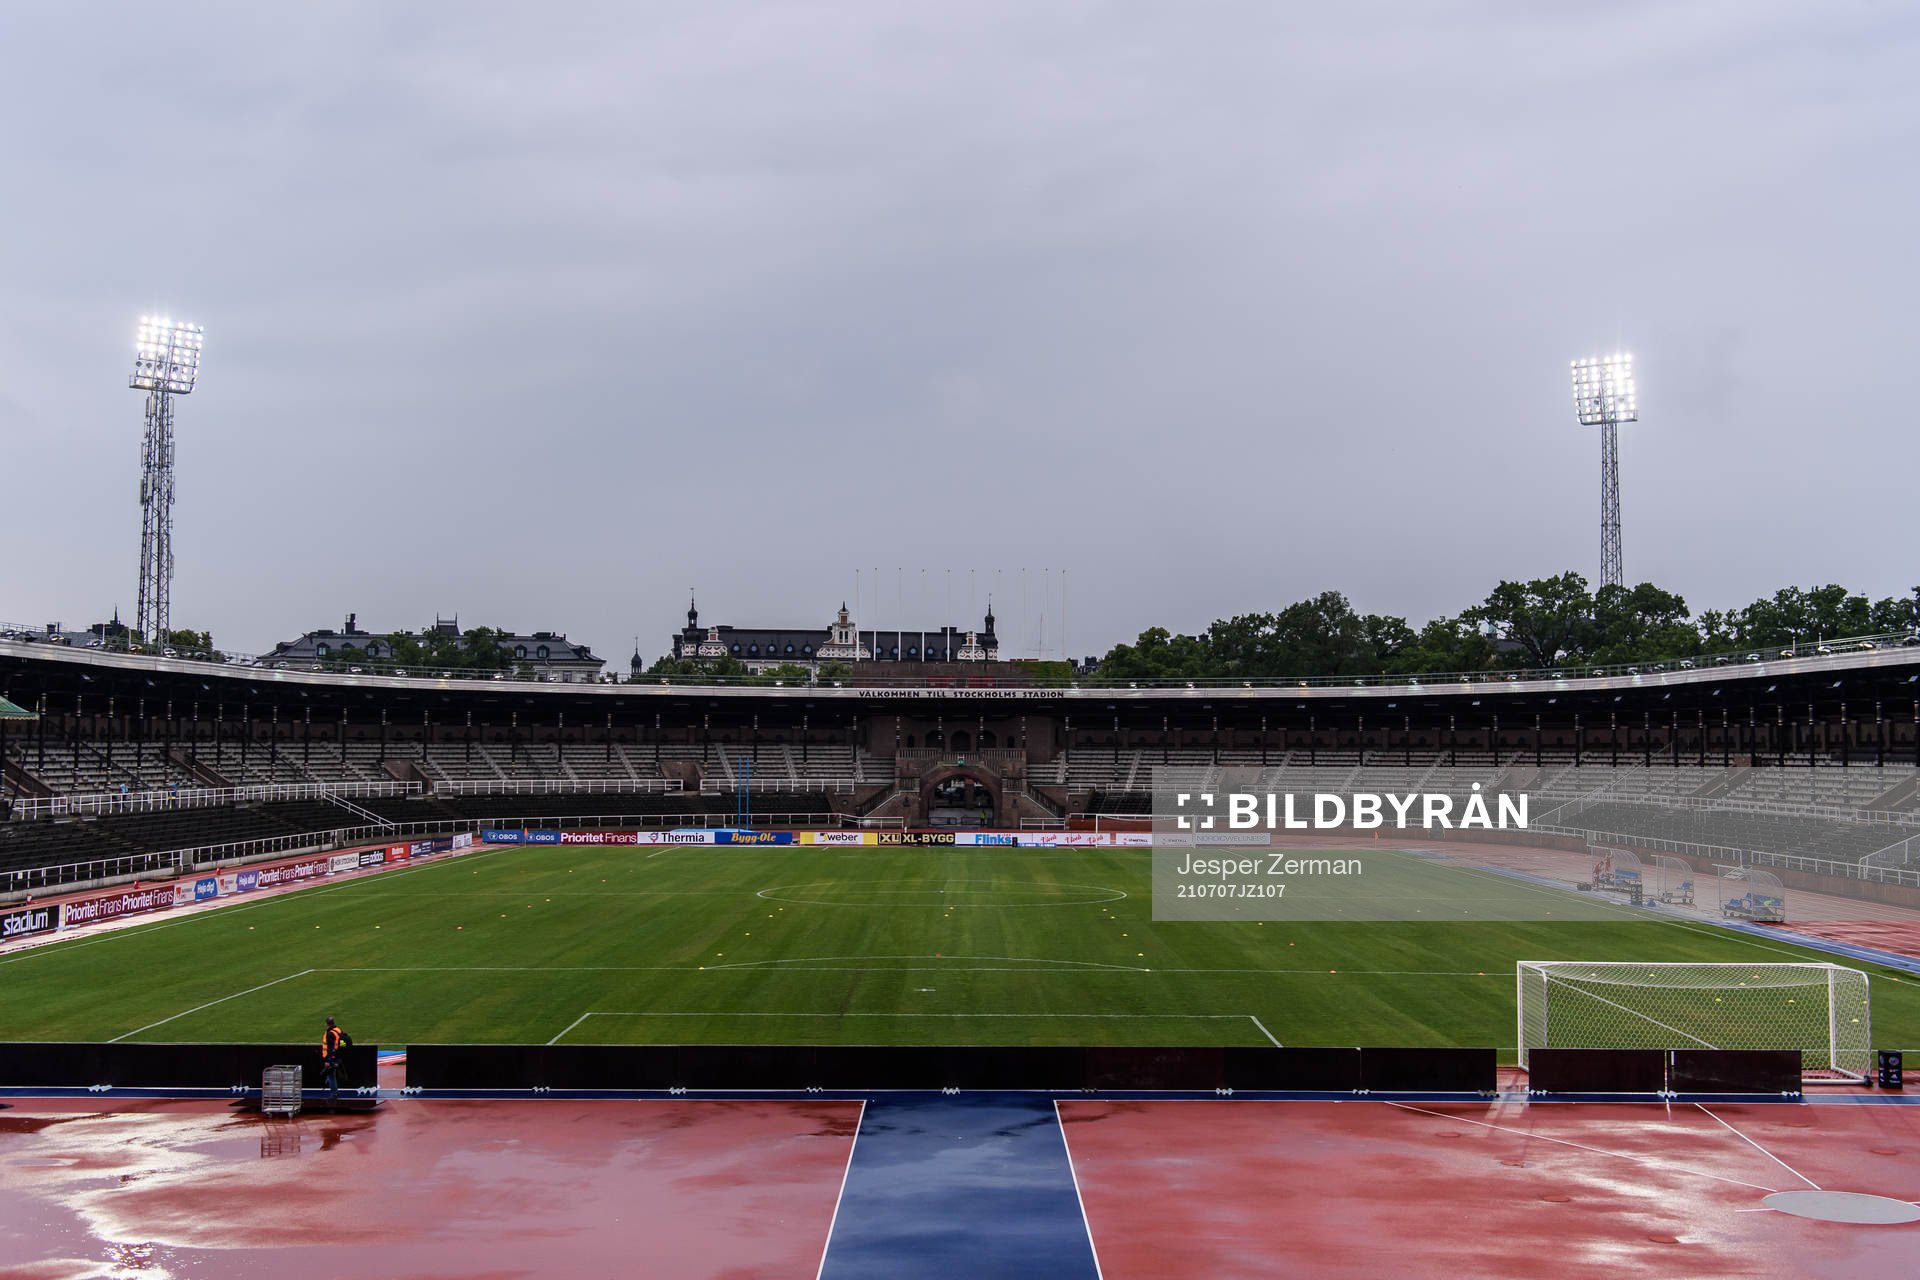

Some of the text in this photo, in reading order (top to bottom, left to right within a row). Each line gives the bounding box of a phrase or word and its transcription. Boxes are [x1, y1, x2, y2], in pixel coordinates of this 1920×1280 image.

[926, 690, 946, 698] TILL
[953, 690, 1017, 698] STOCKHOLMS
[1022, 690, 1065, 698] STADION
[560, 832, 637, 843] Prioritet Finans
[662, 832, 705, 843] Thermia
[731, 832, 776, 843] Bygg-Ole
[827, 832, 858, 841] weber
[902, 833, 954, 843] XL-BYGG
[975, 833, 1012, 844] Flinks
[369, 851, 384, 863] adidas
[65, 889, 174, 923] Prioritet Finans Prioritet Finans
[3, 910, 48, 936] stadium
